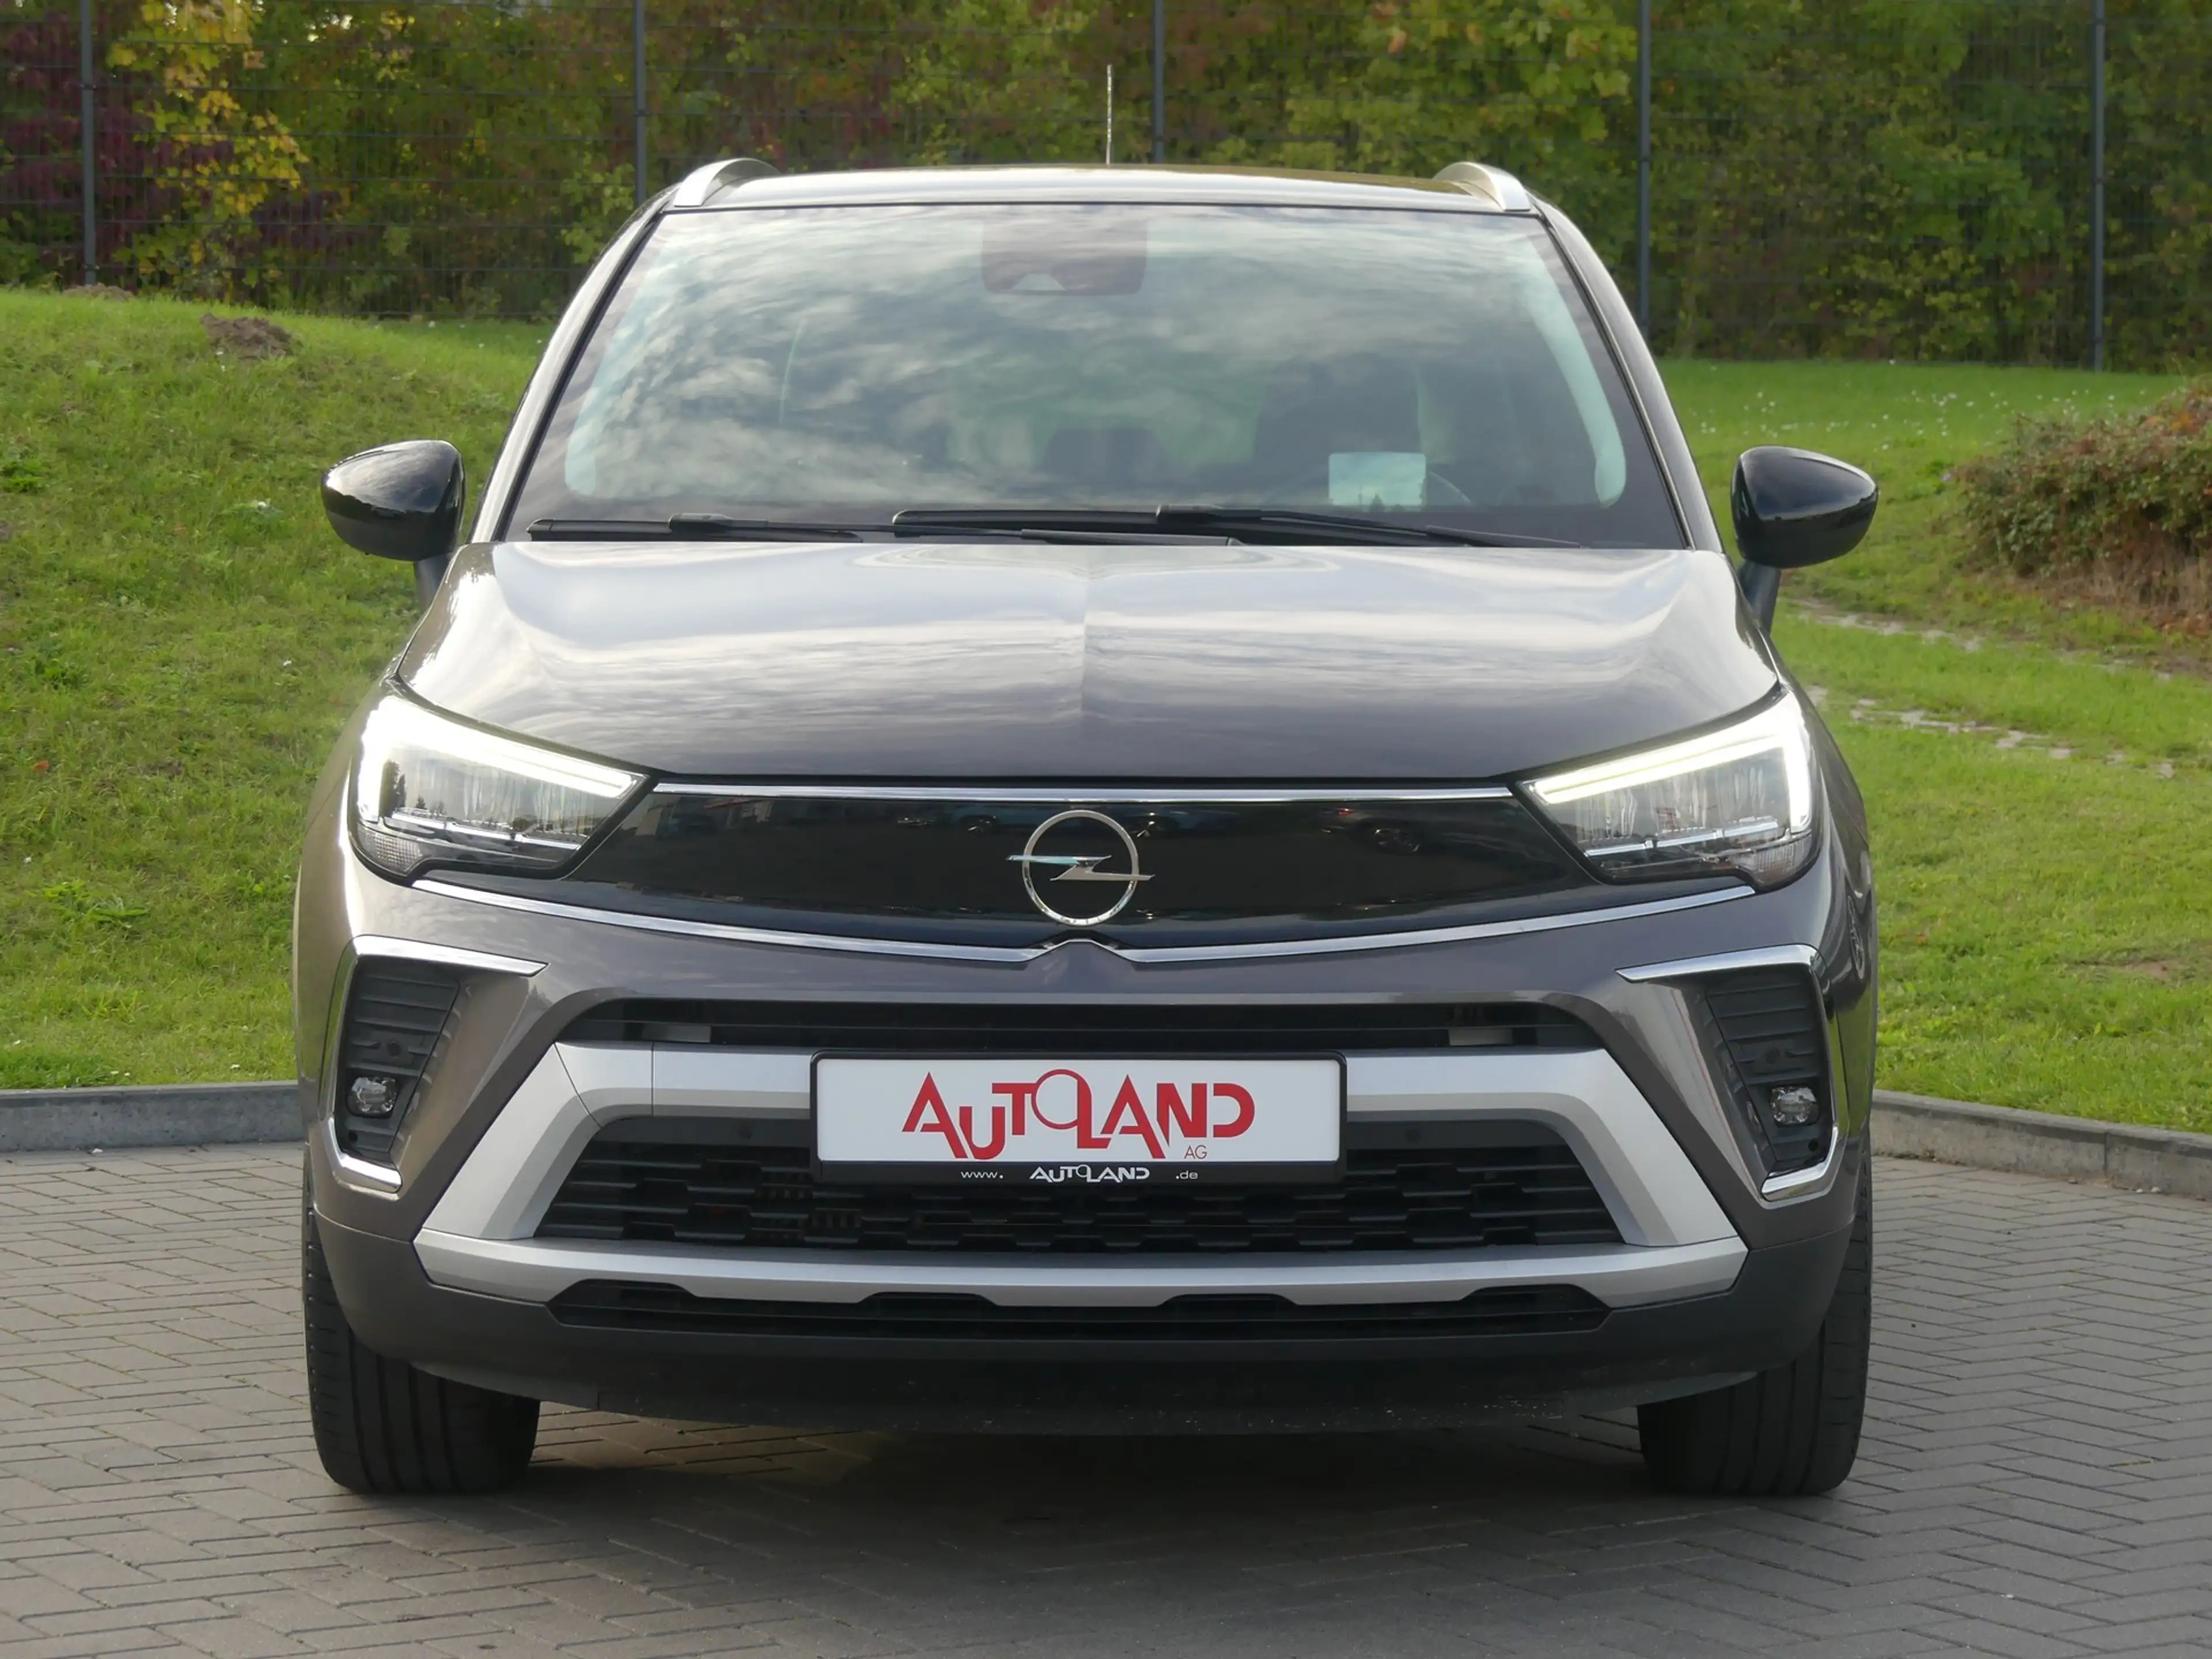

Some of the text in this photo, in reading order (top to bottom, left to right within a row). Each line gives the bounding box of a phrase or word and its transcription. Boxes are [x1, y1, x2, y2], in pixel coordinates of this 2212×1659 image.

[901, 1069, 1255, 1160] AUTOLAND
[1184, 1145, 1207, 1160] AG
[960, 1164, 1198, 1183] www. AUTOLAND .de
